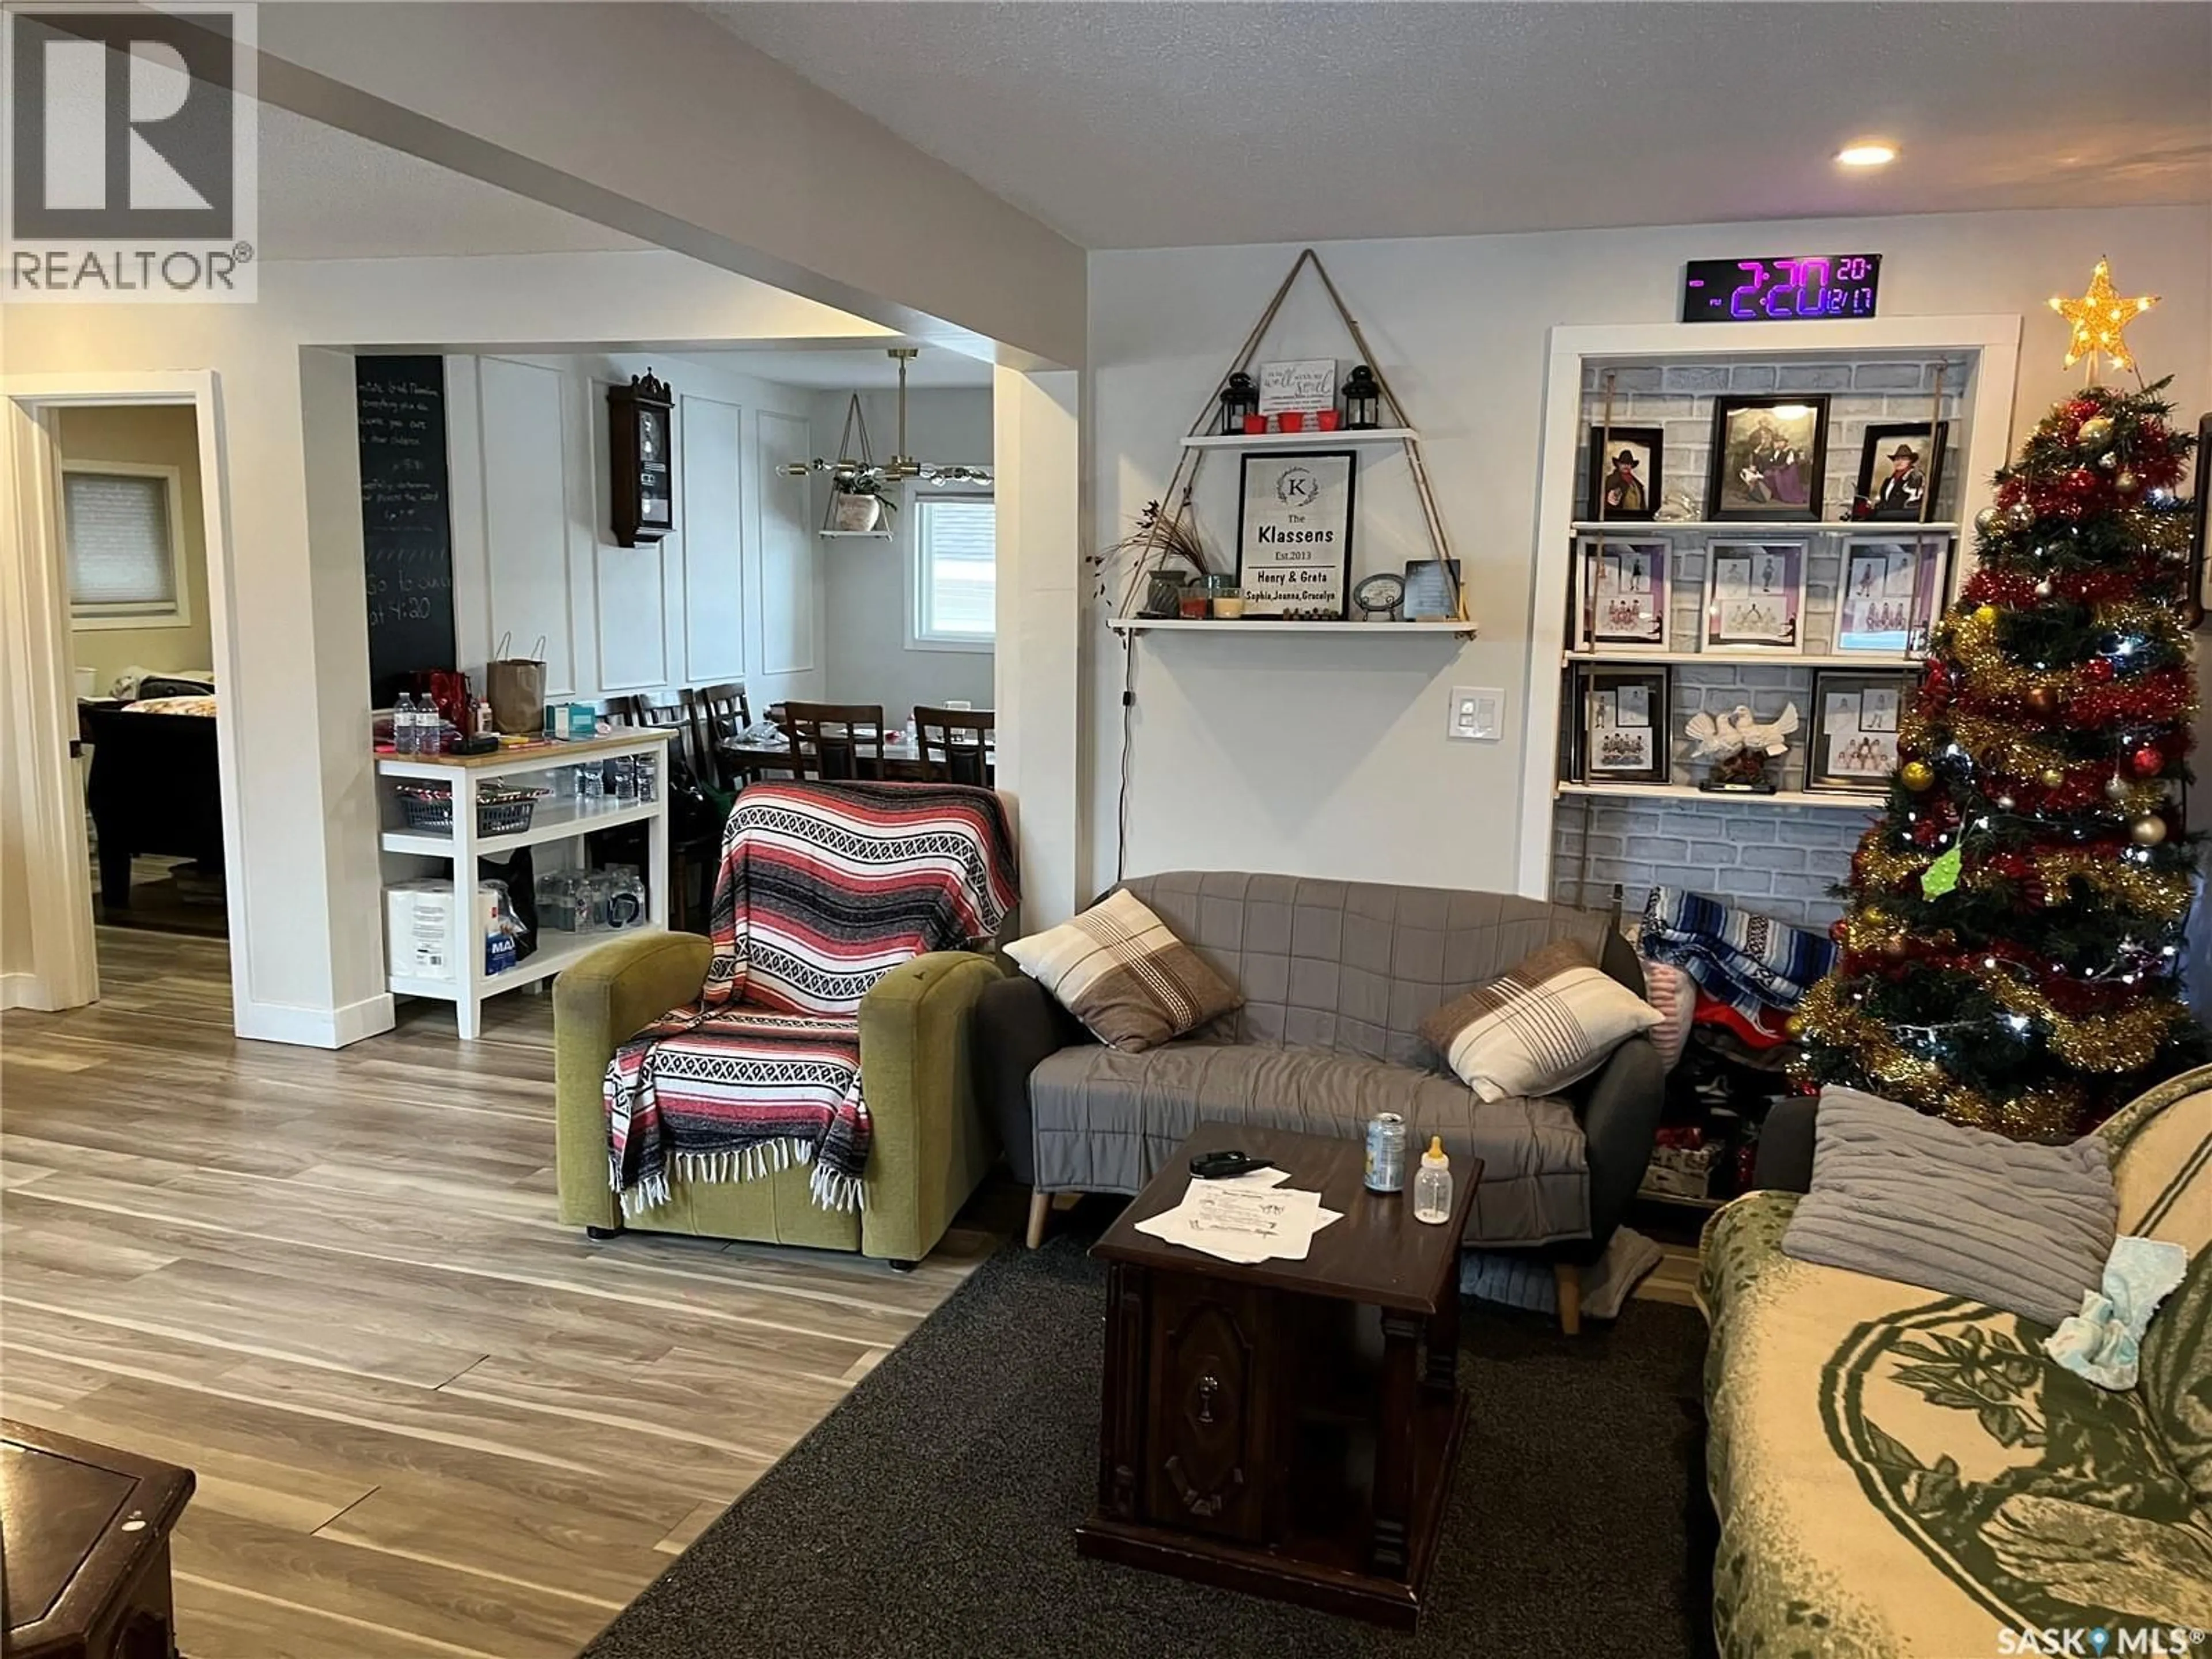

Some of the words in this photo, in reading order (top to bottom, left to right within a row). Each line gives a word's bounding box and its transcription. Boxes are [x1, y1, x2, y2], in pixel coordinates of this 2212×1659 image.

[1730, 258, 1830, 316] 2:20
[1289, 479, 1306, 495] K
[1289, 515, 1305, 523] The
[1259, 526, 1334, 543] Klassens
[1257, 570, 1285, 586] Henry
[1288, 571, 1296, 582] &
[1301, 571, 1327, 583] Greta
